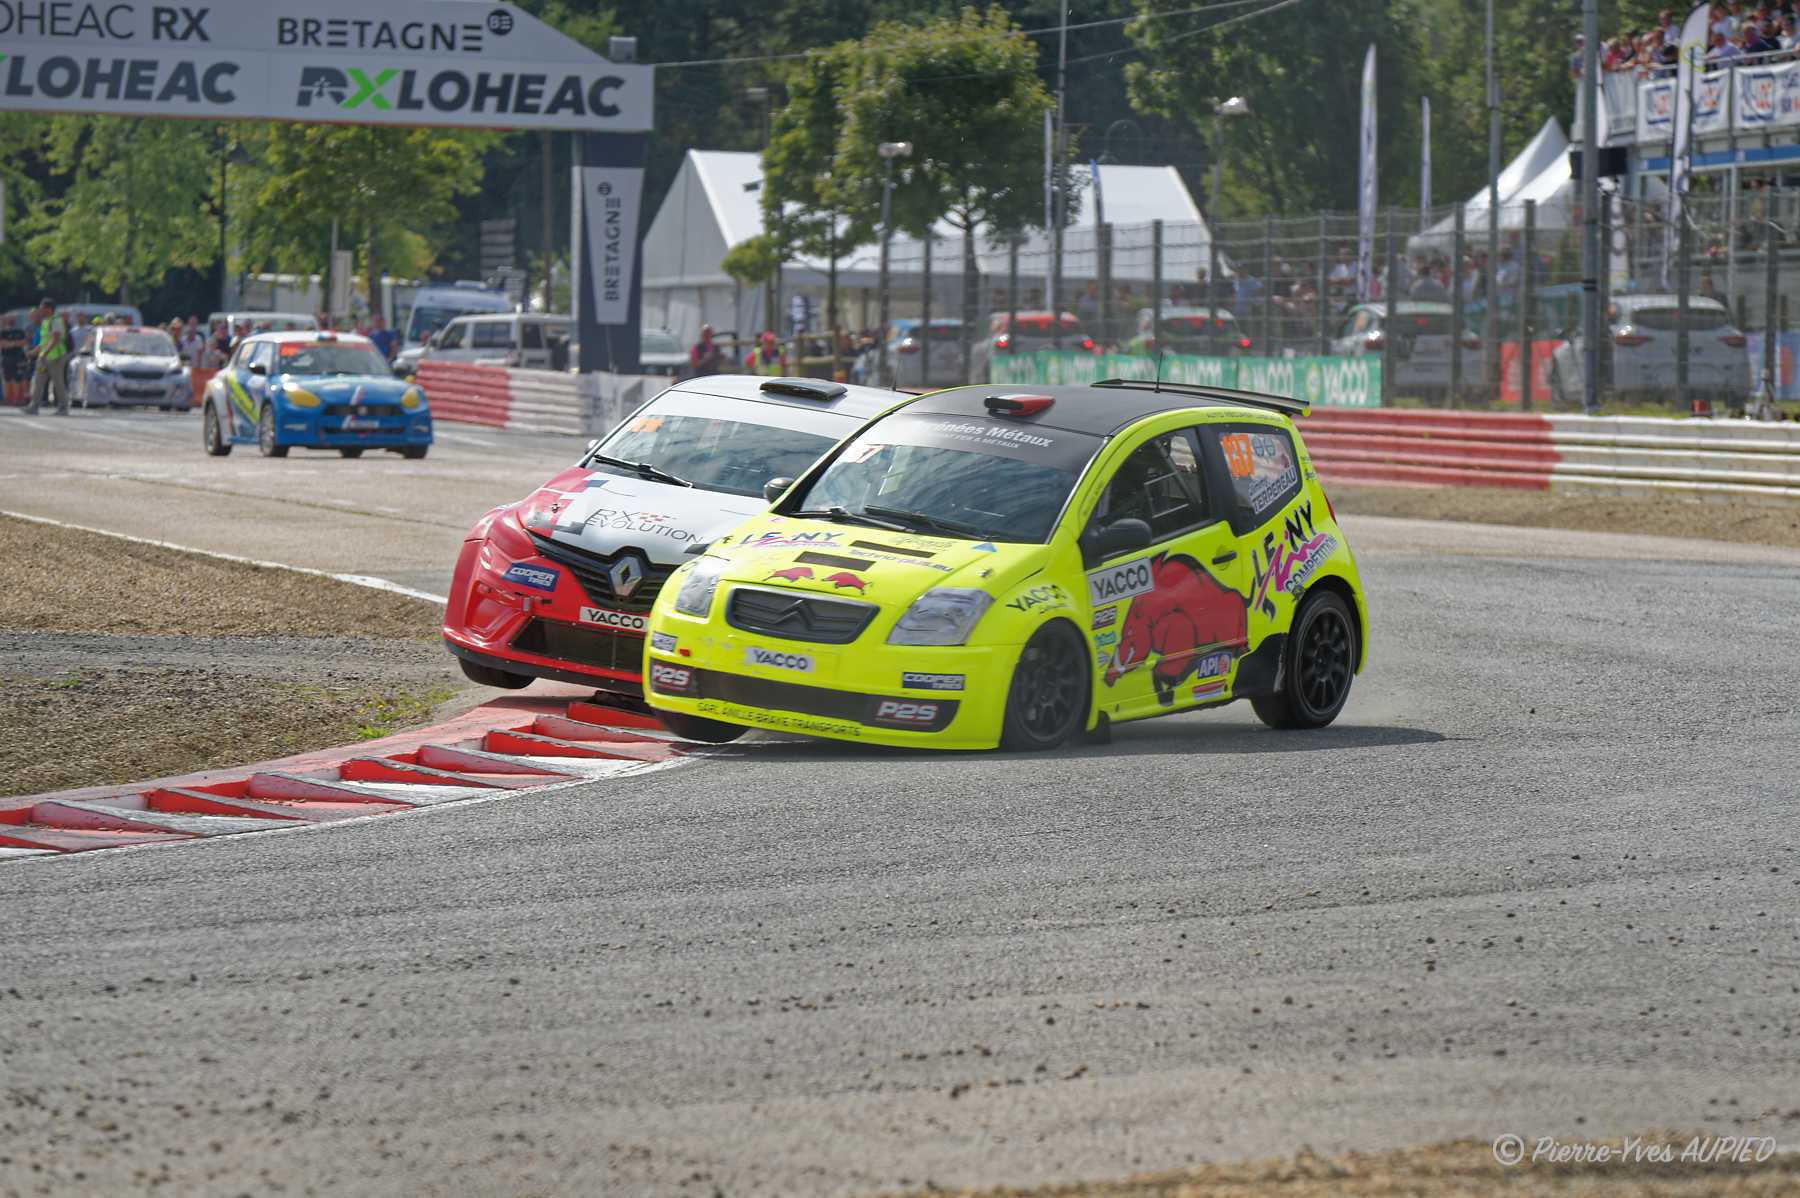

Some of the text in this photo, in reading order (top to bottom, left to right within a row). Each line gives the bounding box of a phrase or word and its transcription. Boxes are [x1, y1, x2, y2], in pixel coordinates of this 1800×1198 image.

[152, 6, 210, 42] RX
[277, 17, 483, 52] BRETAGNE
[0, 54, 241, 104] LOHEAC
[604, 197, 621, 302] BRETAGNE
[1322, 358, 1369, 405] YACCO
[986, 425, 1056, 448] Métaux
[511, 566, 555, 582] COOPER
[1093, 564, 1150, 599] YACCO
[587, 609, 644, 629] YACCO
[754, 651, 808, 670] YACCO
[652, 665, 689, 686] P2S
[877, 701, 938, 721] P2S
